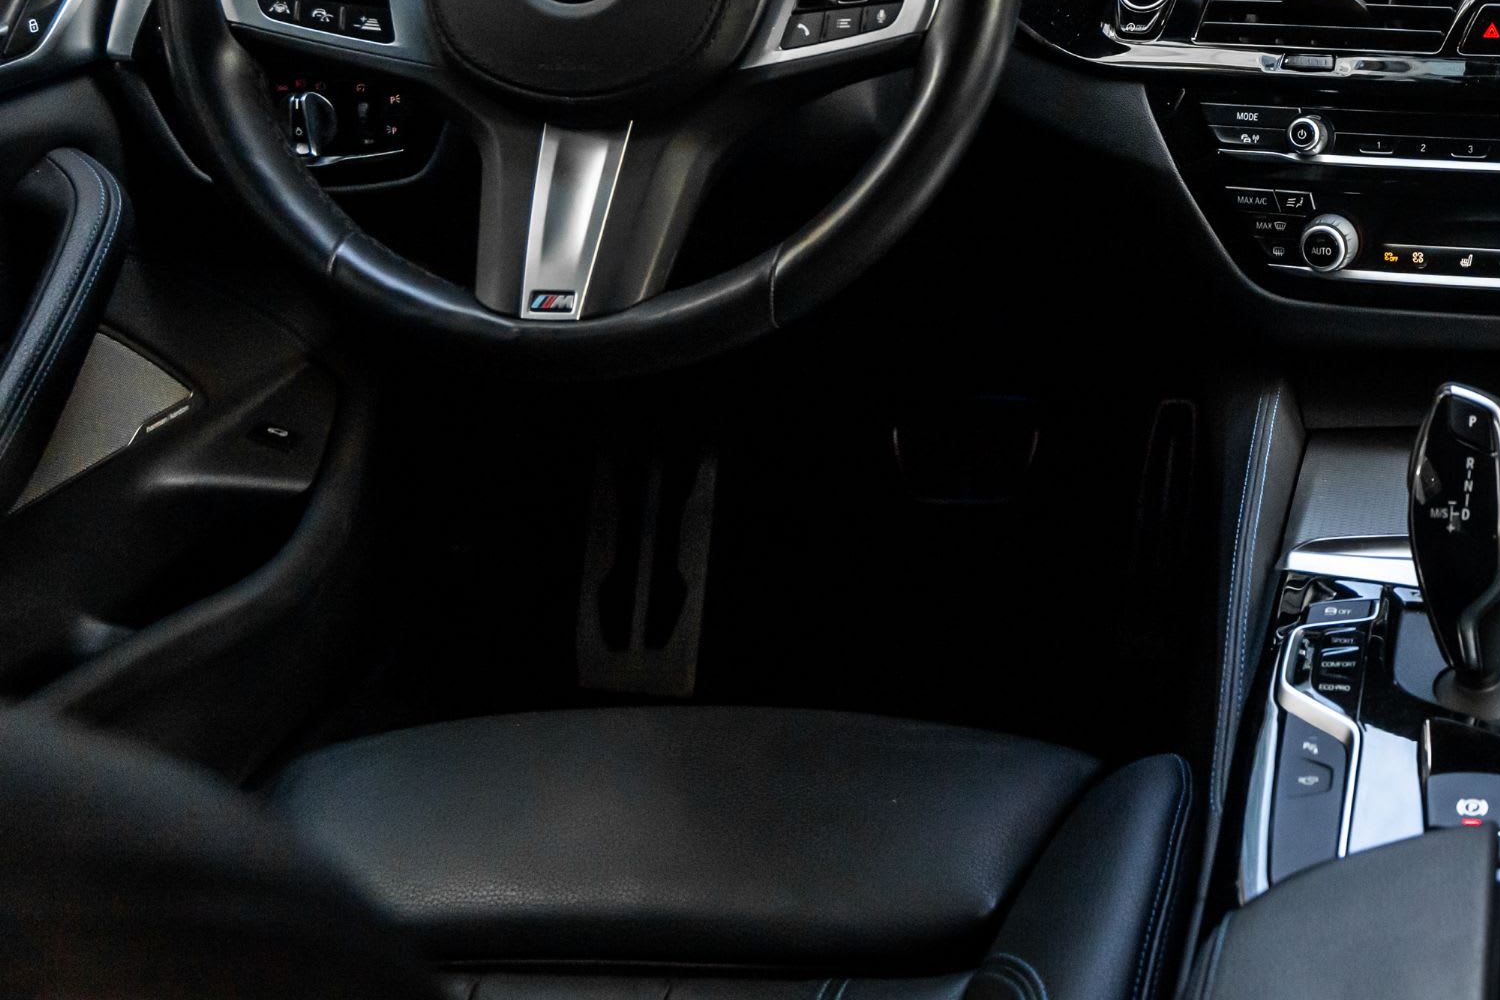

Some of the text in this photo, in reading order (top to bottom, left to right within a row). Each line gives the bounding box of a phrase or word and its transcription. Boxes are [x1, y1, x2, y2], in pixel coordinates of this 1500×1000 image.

[1236, 111, 1259, 122] MODE
[1376, 141, 1381, 149] 1
[1420, 144, 1426, 152] 2
[1467, 145, 1474, 153] 3
[1237, 195, 1268, 206] MAX A/C
[1255, 221, 1273, 230] MAX
[1311, 246, 1332, 256] AUTO
[1468, 415, 1478, 428] P
[1465, 456, 1475, 470] R
[1463, 480, 1474, 492] N
[1461, 507, 1470, 521] D
[1331, 637, 1354, 645] SPORT
[1320, 660, 1357, 669] COMFORT
